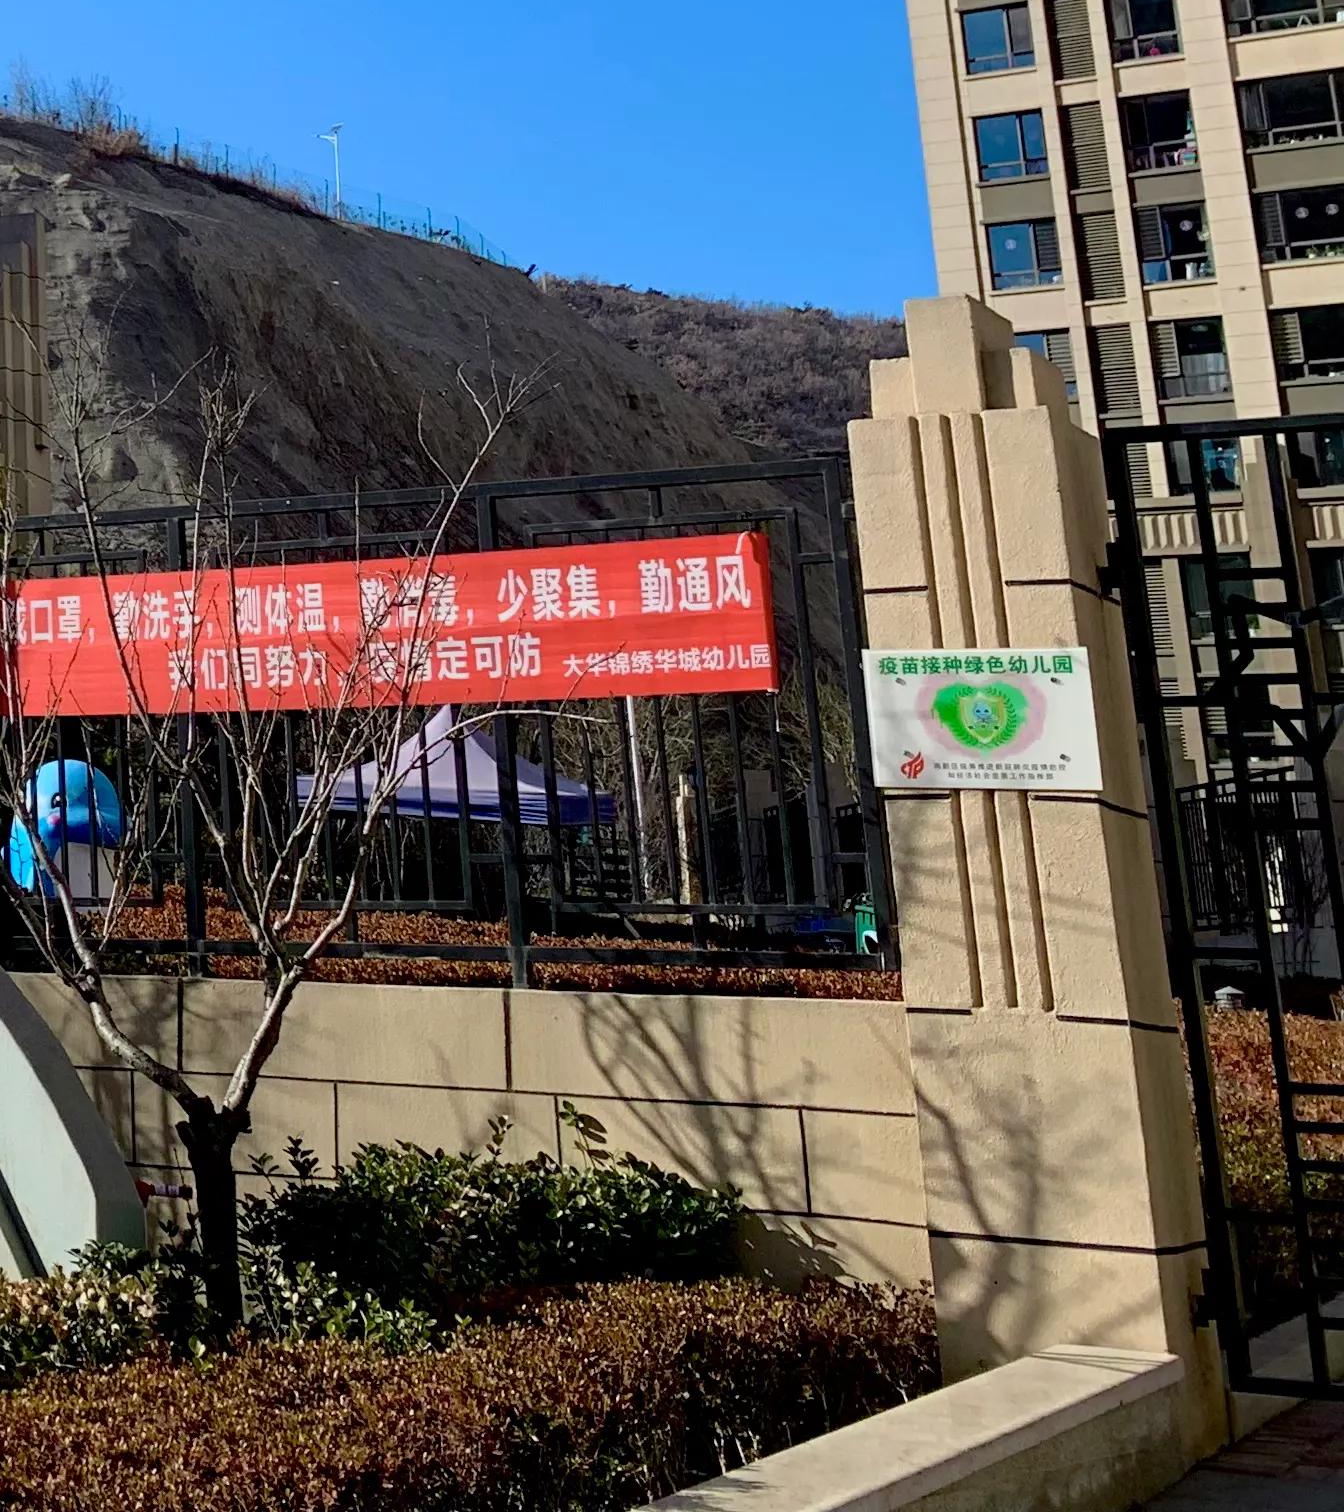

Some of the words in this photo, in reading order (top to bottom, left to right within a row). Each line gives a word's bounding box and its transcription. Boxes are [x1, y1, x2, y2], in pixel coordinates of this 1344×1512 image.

[562, 643, 772, 678] 大华锦绣华城幼儿园
[878, 654, 1074, 676] 疫苗接种绿色幼儿园
